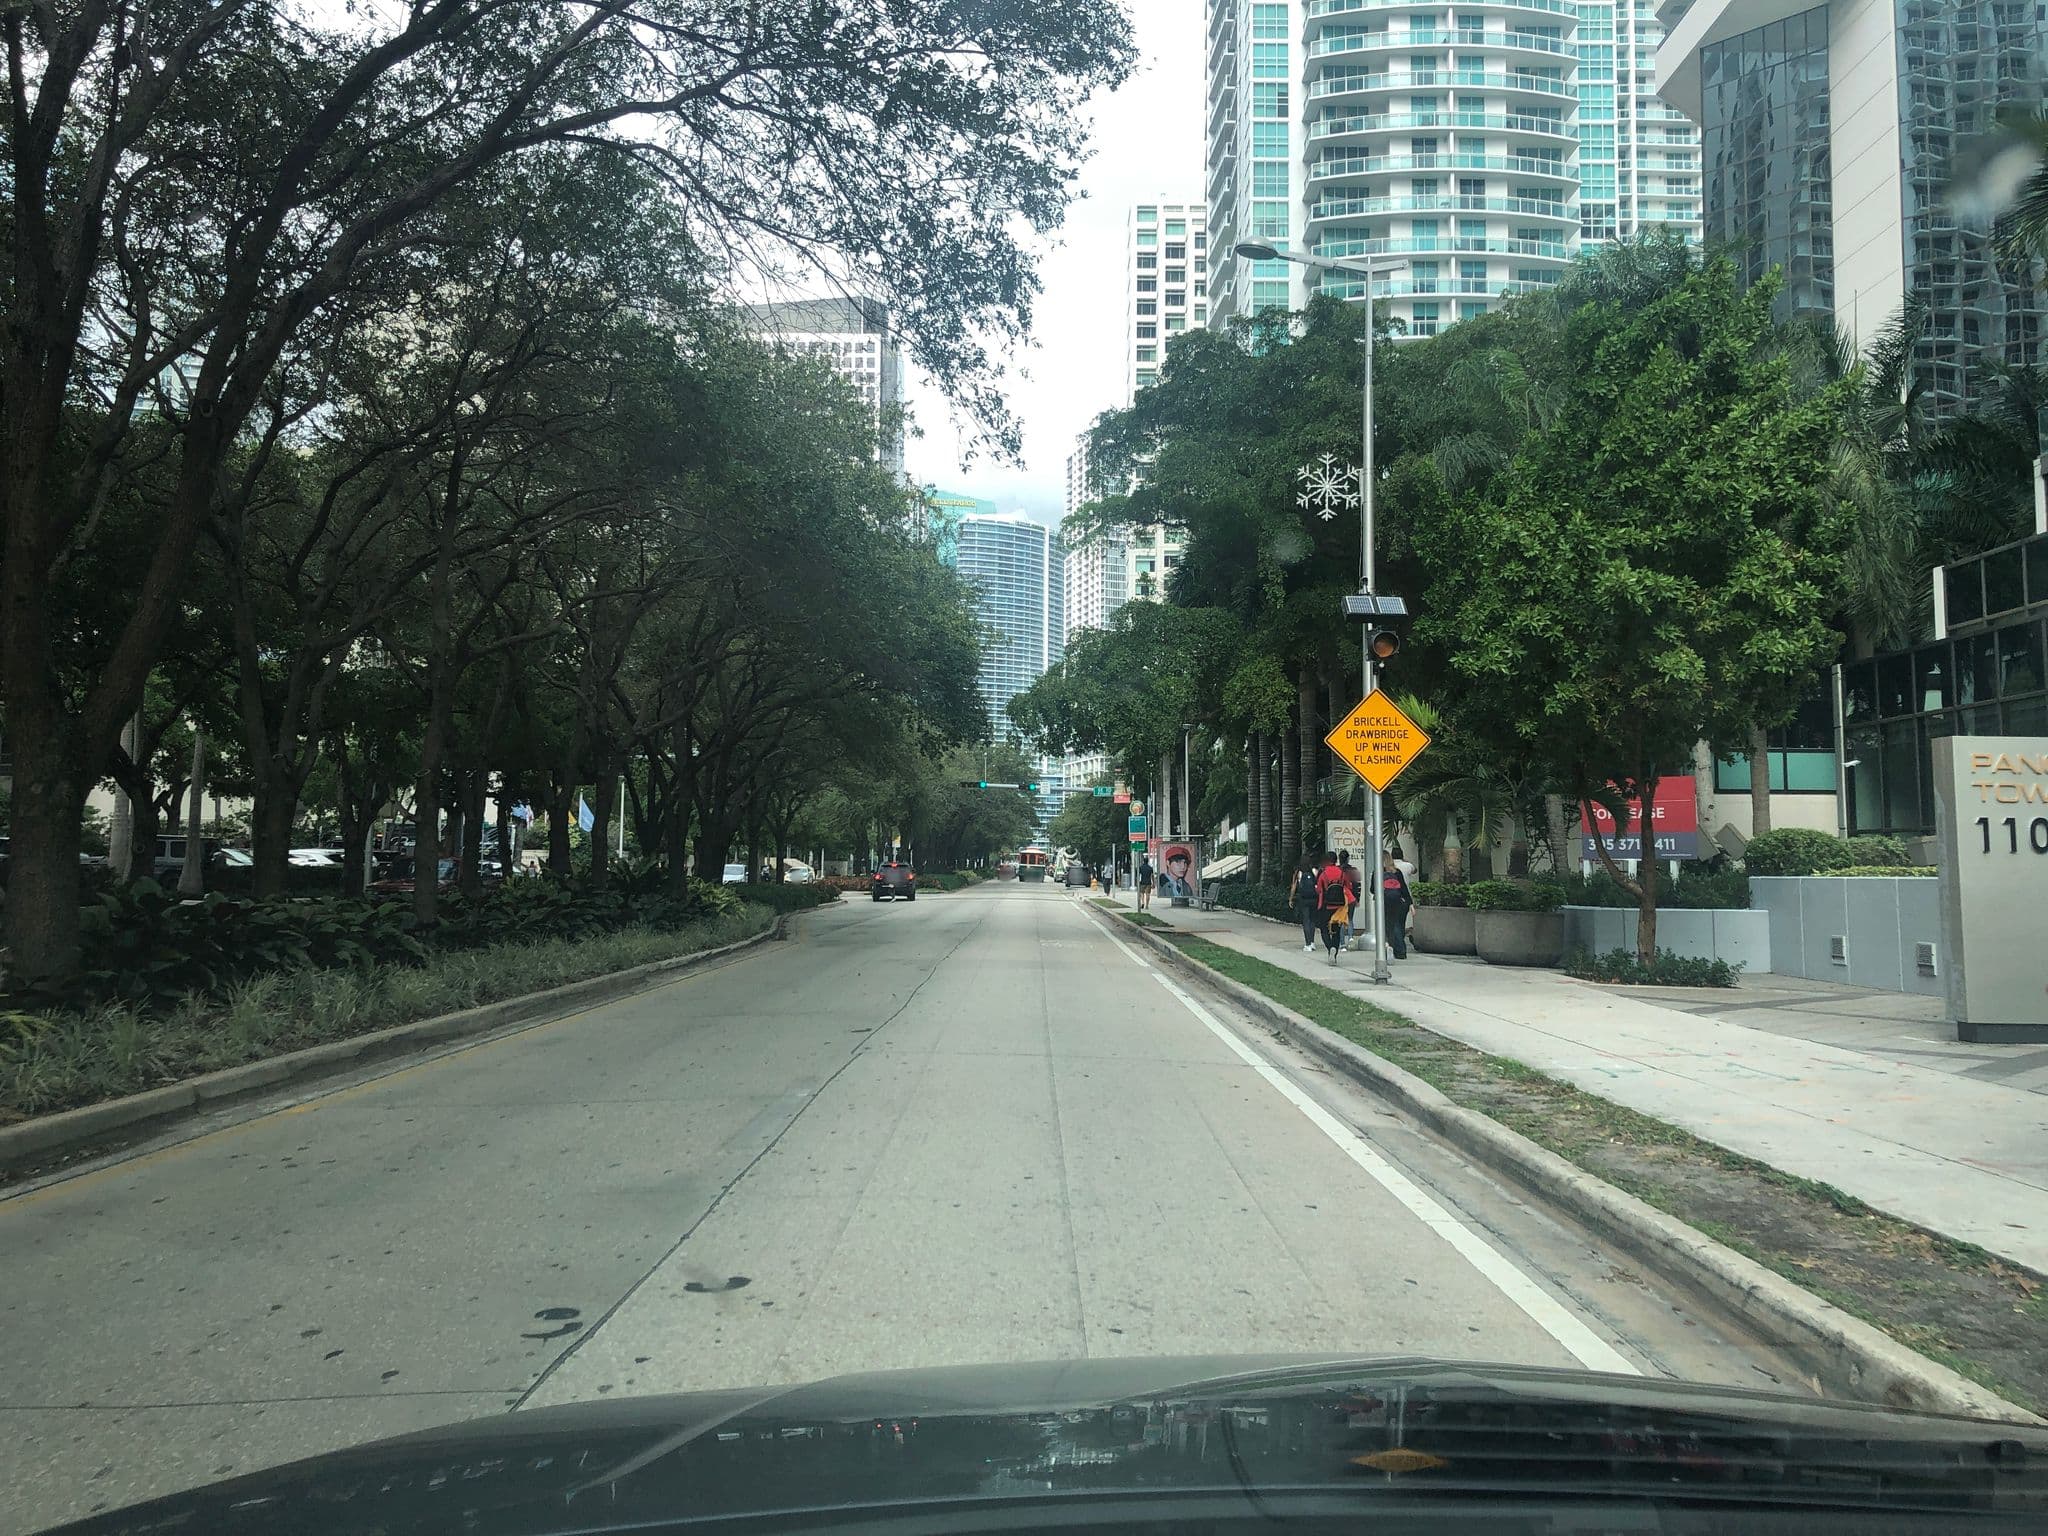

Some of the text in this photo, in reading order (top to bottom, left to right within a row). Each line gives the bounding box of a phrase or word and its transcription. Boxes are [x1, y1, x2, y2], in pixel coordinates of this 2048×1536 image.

[1354, 717, 1400, 727] BRICKELL
[1346, 730, 1409, 739] DRAWBRIDGE
[1355, 743, 1400, 751] UP WHEN
[1354, 755, 1402, 764] FLASHING
[1971, 753, 2048, 775] PAN
[1971, 780, 2048, 804] TOW
[1334, 827, 1364, 835] PAN
[1975, 817, 2048, 855] 110
[1588, 839, 1614, 850] 35
[1618, 839, 1640, 850] 371
